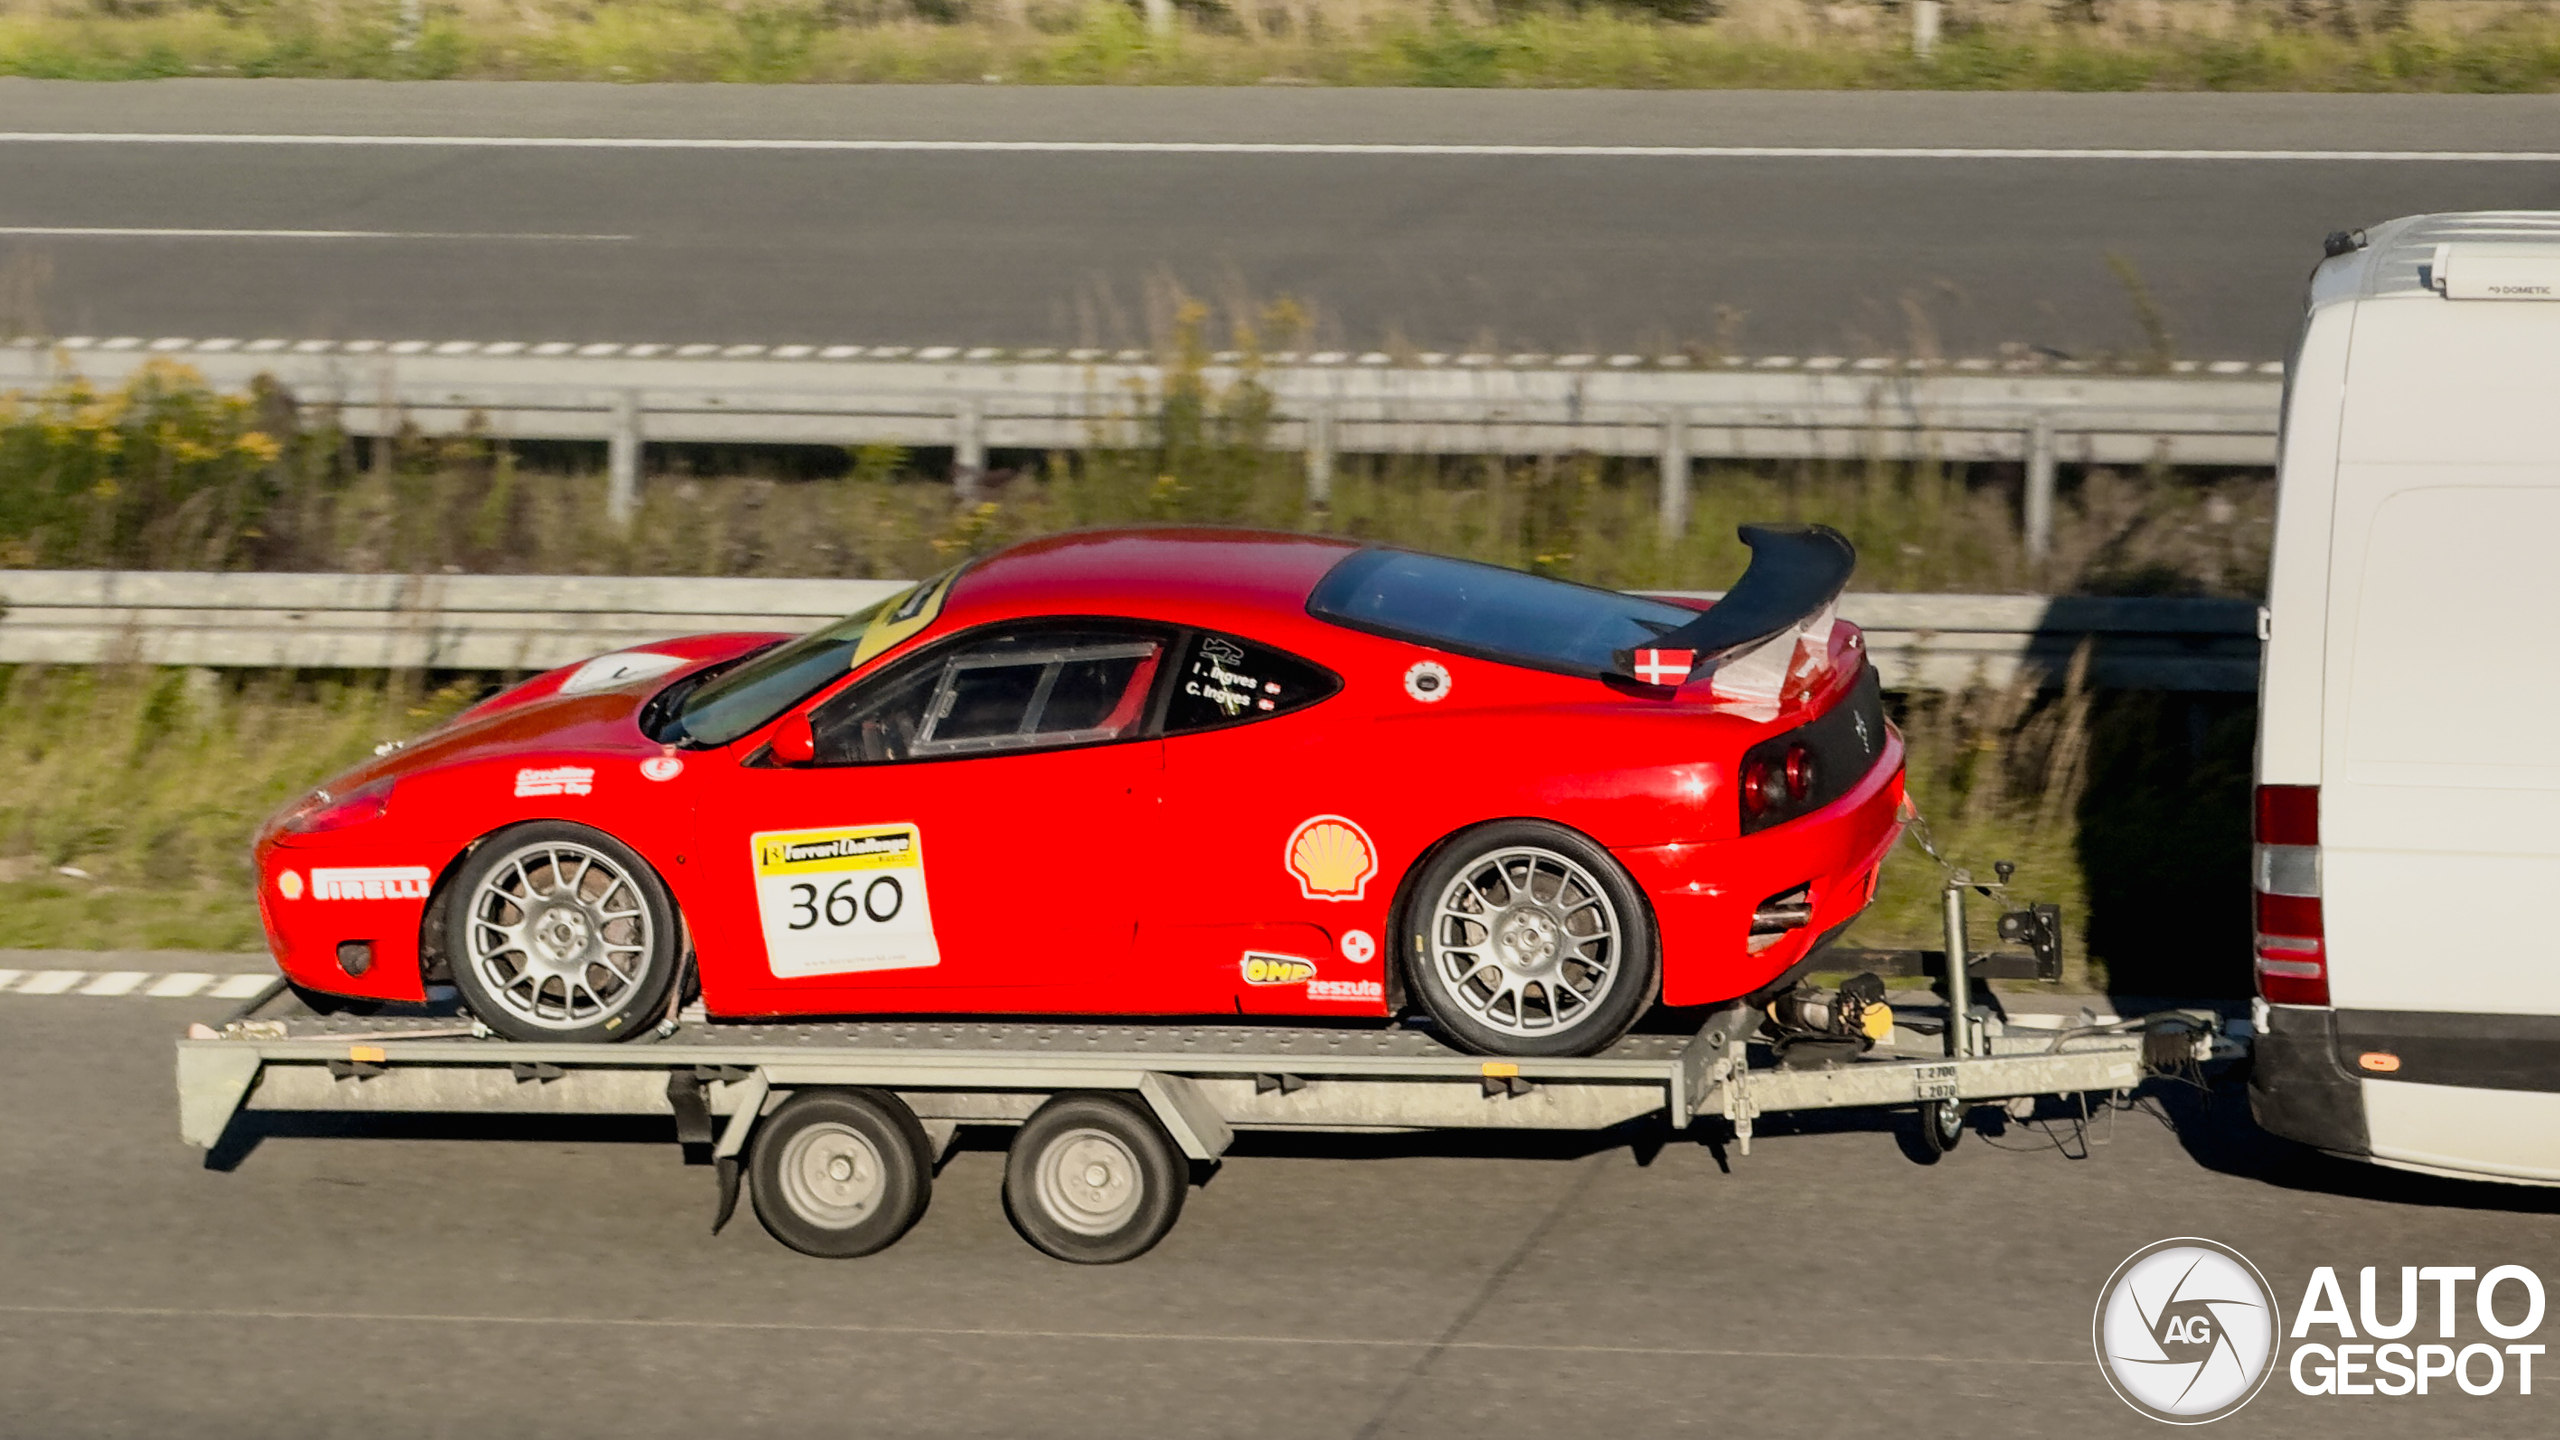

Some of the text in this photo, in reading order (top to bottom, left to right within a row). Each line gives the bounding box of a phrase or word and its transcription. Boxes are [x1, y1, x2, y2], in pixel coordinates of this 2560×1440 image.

[2502, 286, 2551, 294] DOMETIC
[1210, 666, 1258, 689] Ingves
[1203, 684, 1251, 706] Ingves
[785, 841, 839, 860] Ferrari
[840, 837, 909, 857] Challenge
[311, 866, 431, 900] PIRELLI
[788, 876, 903, 930] 360
[1247, 958, 1313, 982] OMP
[1307, 980, 1382, 996] zeszuta
[1928, 1066, 1956, 1078] 2700
[1929, 1085, 1956, 1098] 2070
